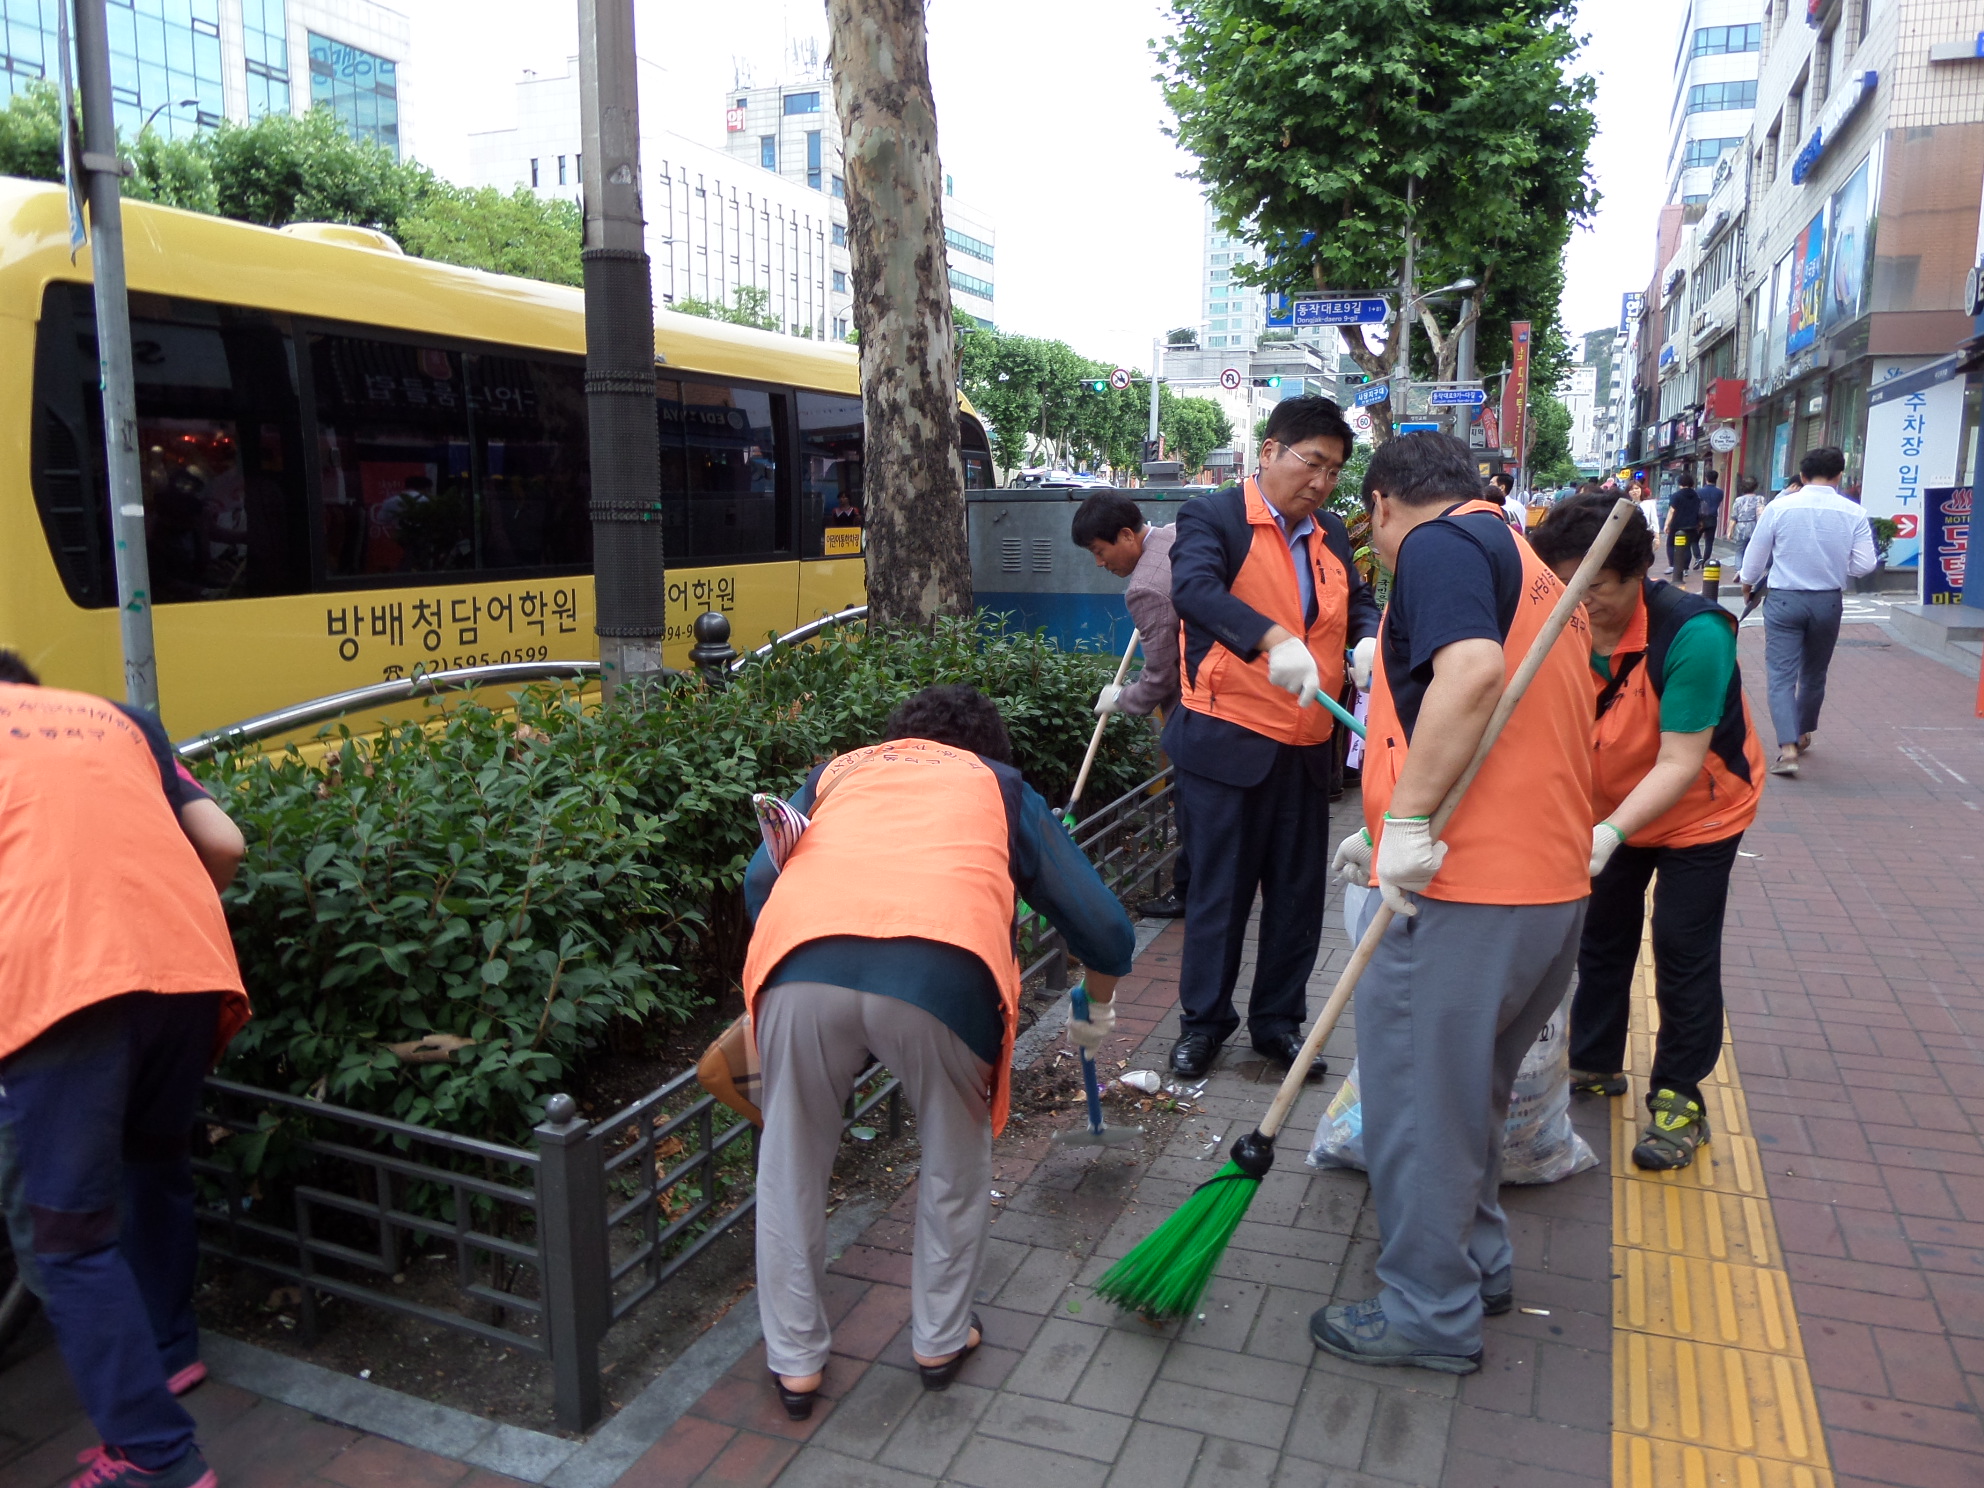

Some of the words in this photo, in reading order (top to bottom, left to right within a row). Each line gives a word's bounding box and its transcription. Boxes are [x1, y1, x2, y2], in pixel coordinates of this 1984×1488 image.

[1297, 302, 1362, 317] 동작대로9길
[1901, 391, 1927, 457] 주차장
[1895, 464, 1919, 506] 입구
[667, 577, 735, 612] 어학원
[326, 588, 578, 662] 방배청담어학원
